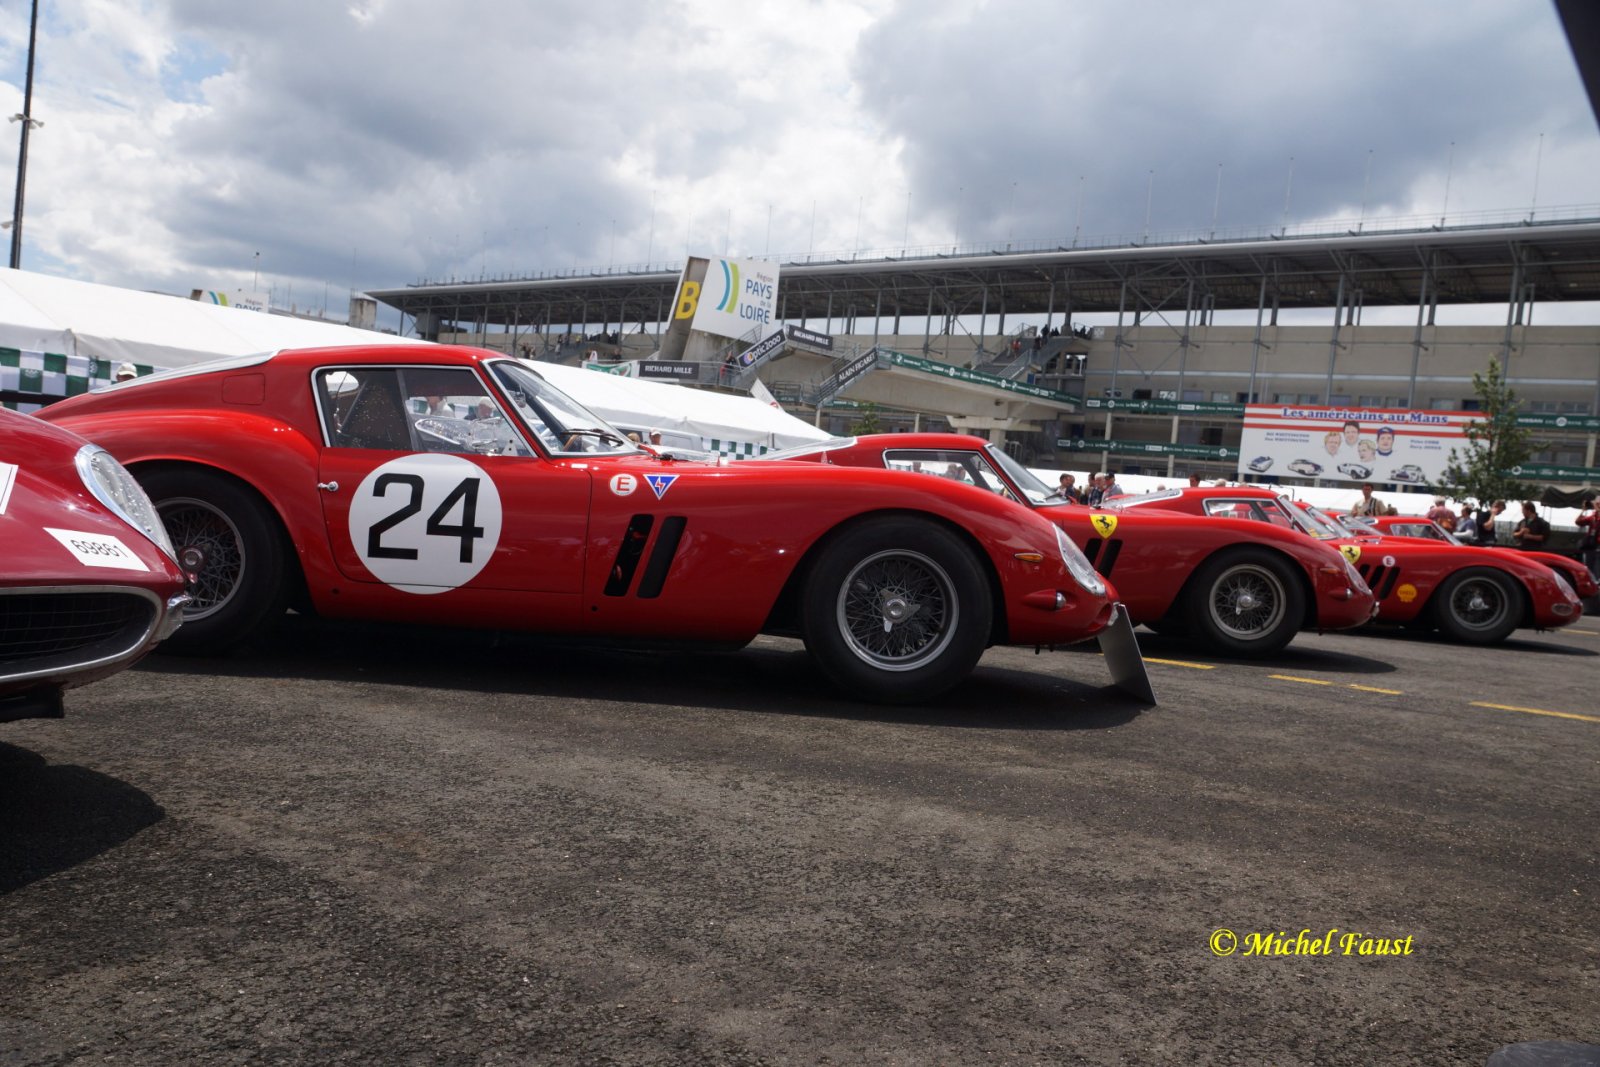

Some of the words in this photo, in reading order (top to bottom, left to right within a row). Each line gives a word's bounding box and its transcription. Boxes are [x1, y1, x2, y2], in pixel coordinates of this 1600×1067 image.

[745, 279, 773, 300] PAYS
[674, 281, 701, 320] B
[740, 303, 770, 325] LOIRE
[764, 335, 781, 352] 2000
[793, 329, 817, 342] RICHARD
[815, 335, 829, 346] MILLE
[644, 364, 672, 373] RICHARD
[673, 366, 693, 374] MILLE
[838, 365, 856, 382] ALAIN
[854, 352, 877, 374] FIGARET
[1282, 408, 1304, 418] Les
[1308, 409, 1384, 422] américains
[1387, 413, 1406, 422] au
[1409, 413, 1449, 425] Mans
[616, 476, 631, 492] E
[367, 472, 485, 564] 24
[70, 539, 129, 558] 69861
